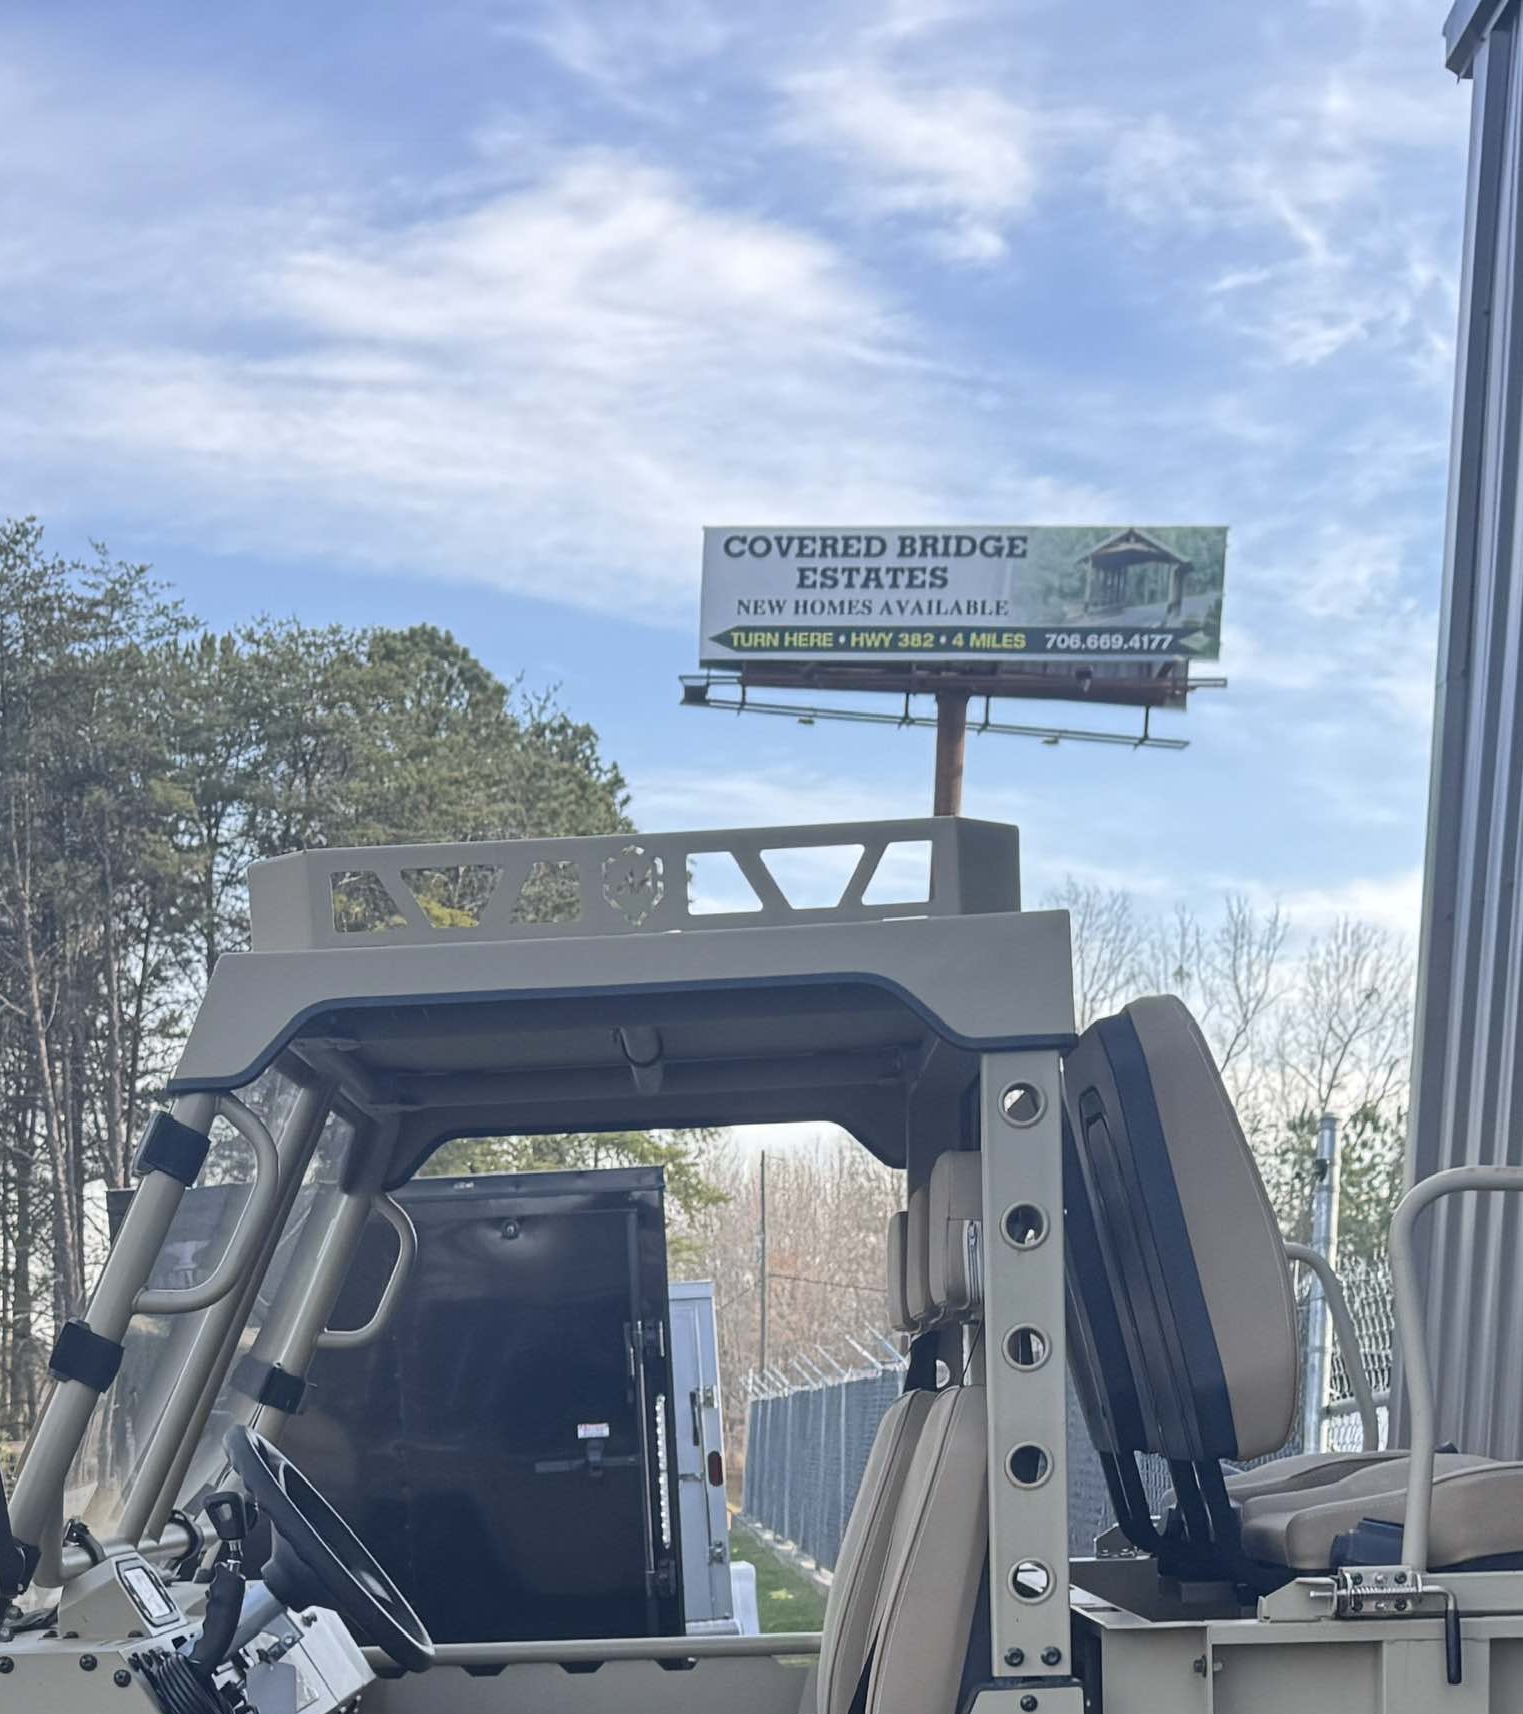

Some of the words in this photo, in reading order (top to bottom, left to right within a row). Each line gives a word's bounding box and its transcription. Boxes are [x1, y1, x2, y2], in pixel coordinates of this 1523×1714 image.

[723, 535, 887, 559] COVERED
[896, 535, 1028, 559] BRIDGE
[796, 566, 948, 590] ESTATES
[737, 599, 786, 616] NEW
[794, 599, 872, 616] HOMES
[880, 599, 1009, 616] AVAILABLE
[730, 632, 779, 648] TURN
[784, 632, 834, 648] HERE
[850, 632, 893, 648] HWY
[898, 632, 934, 648] 382
[951, 632, 965, 648] 4
[969, 633, 1027, 649] MILES
[1044, 633, 1173, 650] 706.669.4177
